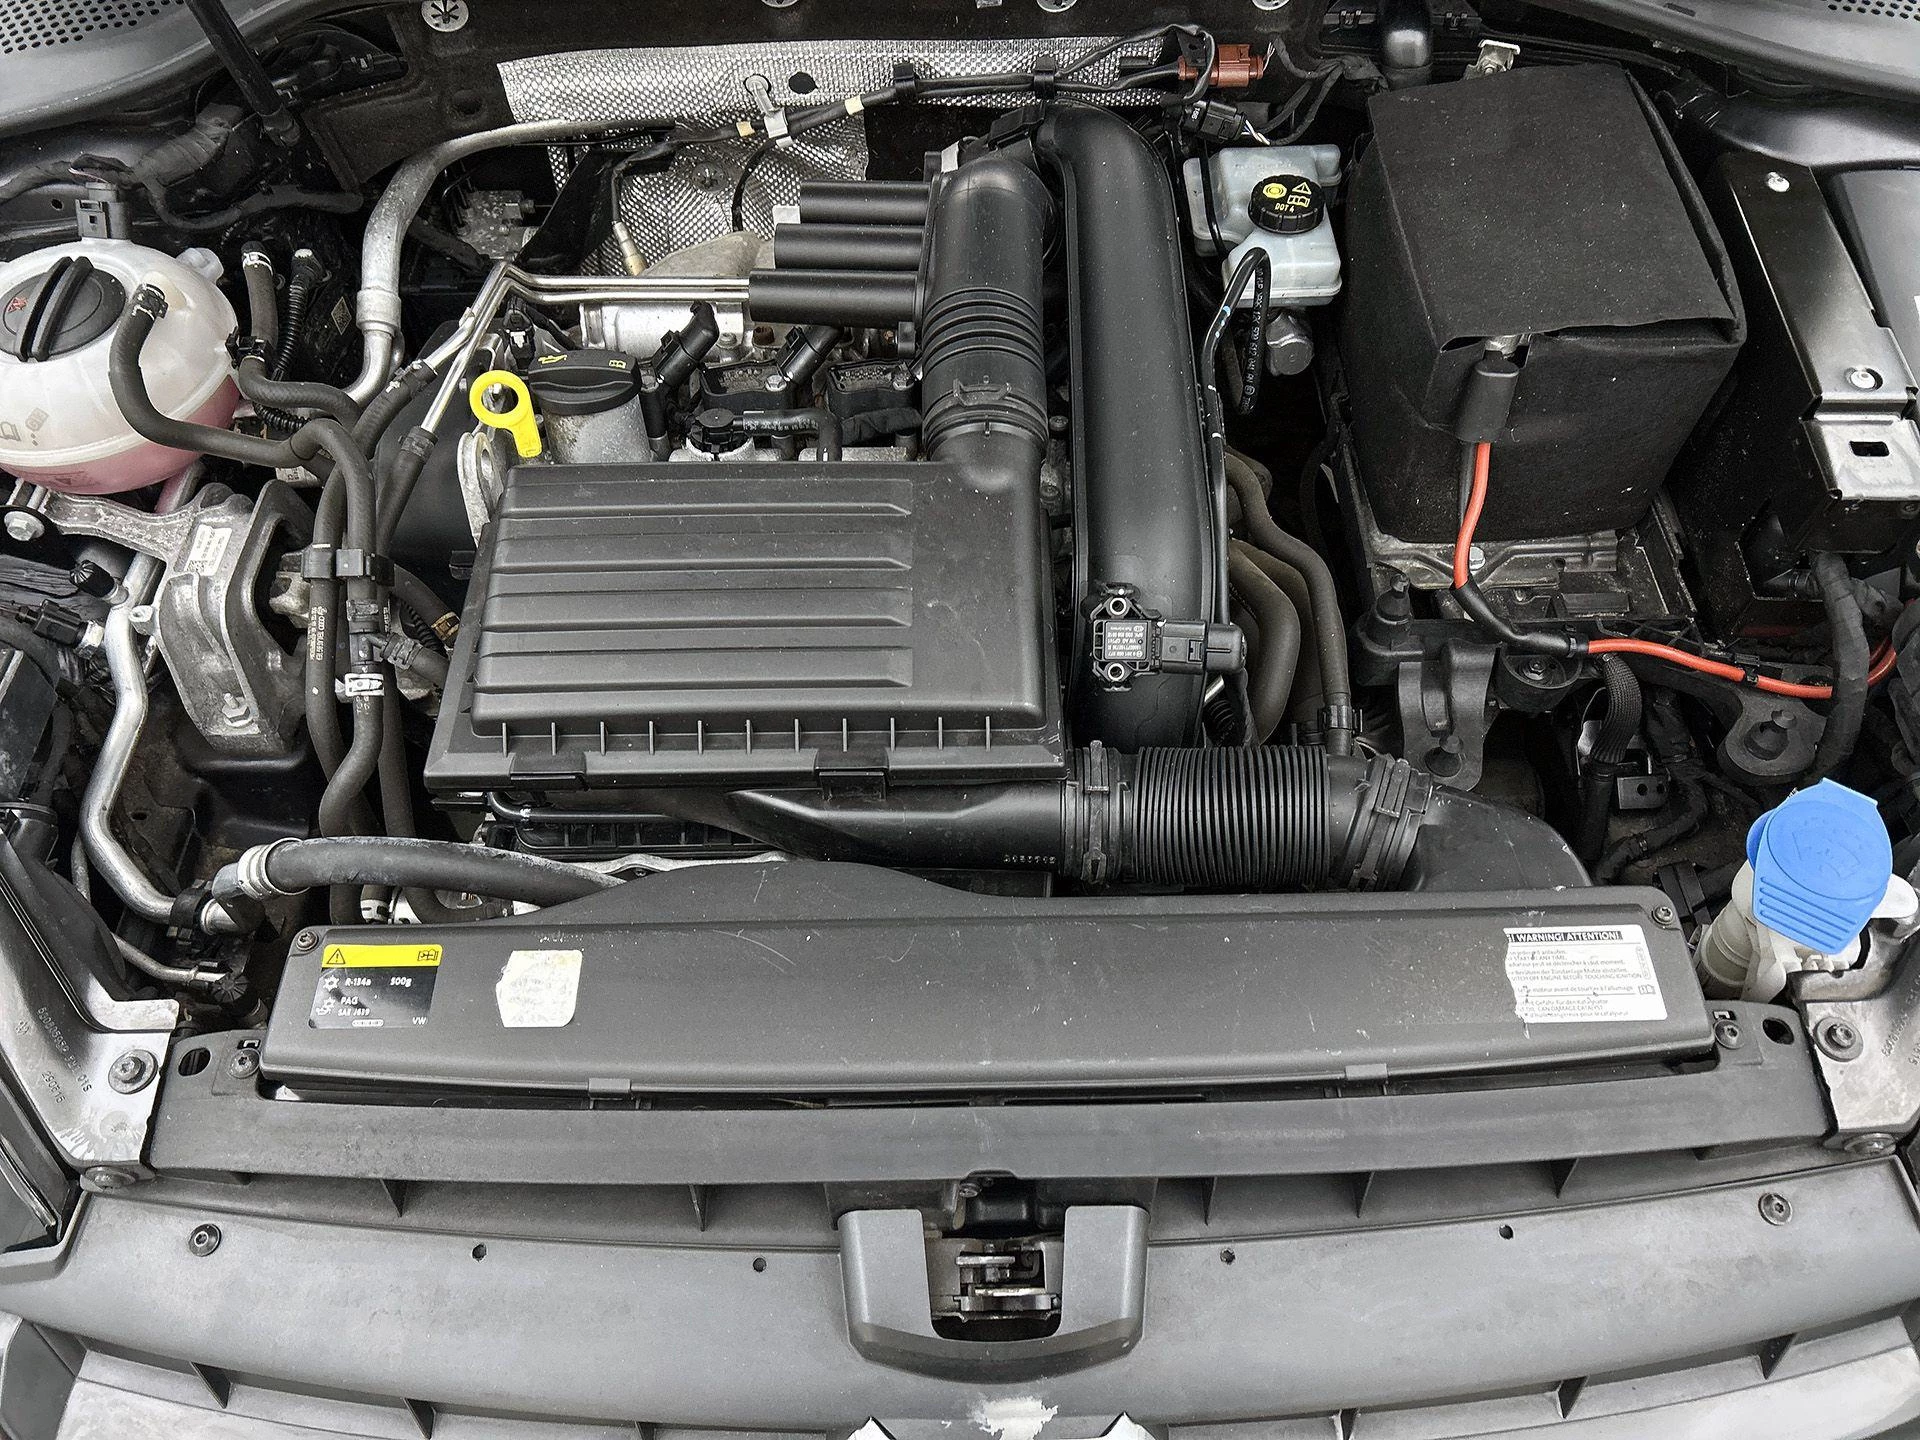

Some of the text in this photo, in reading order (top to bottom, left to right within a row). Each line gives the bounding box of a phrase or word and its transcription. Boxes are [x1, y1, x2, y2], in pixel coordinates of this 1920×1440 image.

[1275, 203, 1289, 211] DOT
[1518, 933, 1565, 943] WARNING!
[1567, 931, 1620, 941] ATTENTION!
[345, 976, 412, 988] R-134a 500g
[340, 996, 359, 1005] PAG
[337, 1008, 352, 1016] SAE
[412, 1017, 427, 1025] VW
